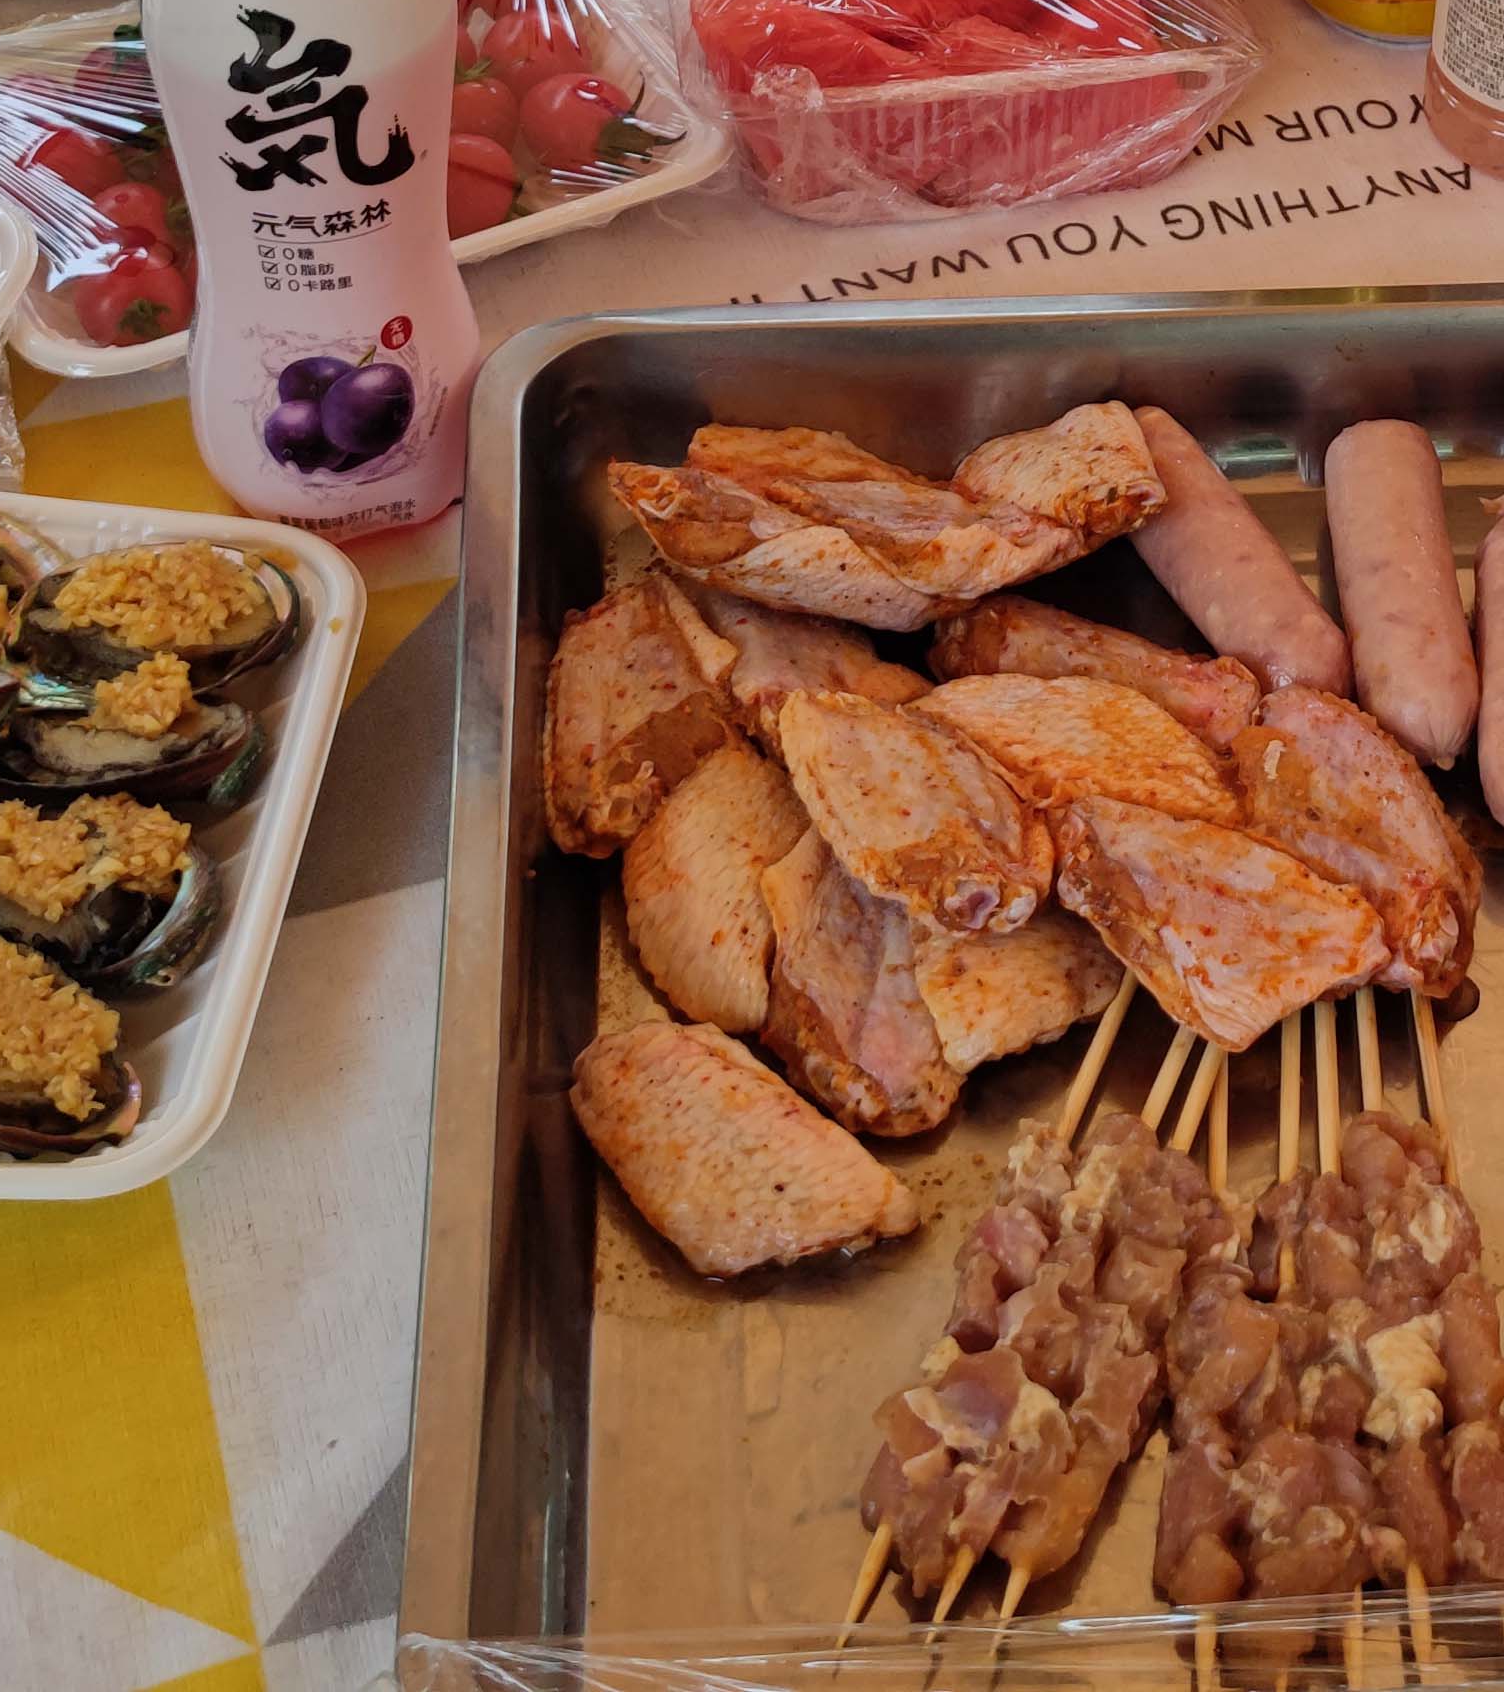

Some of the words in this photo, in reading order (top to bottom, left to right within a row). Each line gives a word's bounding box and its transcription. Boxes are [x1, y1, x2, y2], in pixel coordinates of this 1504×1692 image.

[1264, 93, 1426, 142] YOUR
[252, 198, 392, 238] 元气森林
[1160, 163, 1472, 241] ANYTHING
[282, 247, 315, 261] 0糖
[1006, 215, 1148, 264] YOU
[285, 263, 335, 277] 0脂肪
[287, 275, 353, 292] 0卡路里
[801, 249, 989, 303] WANT
